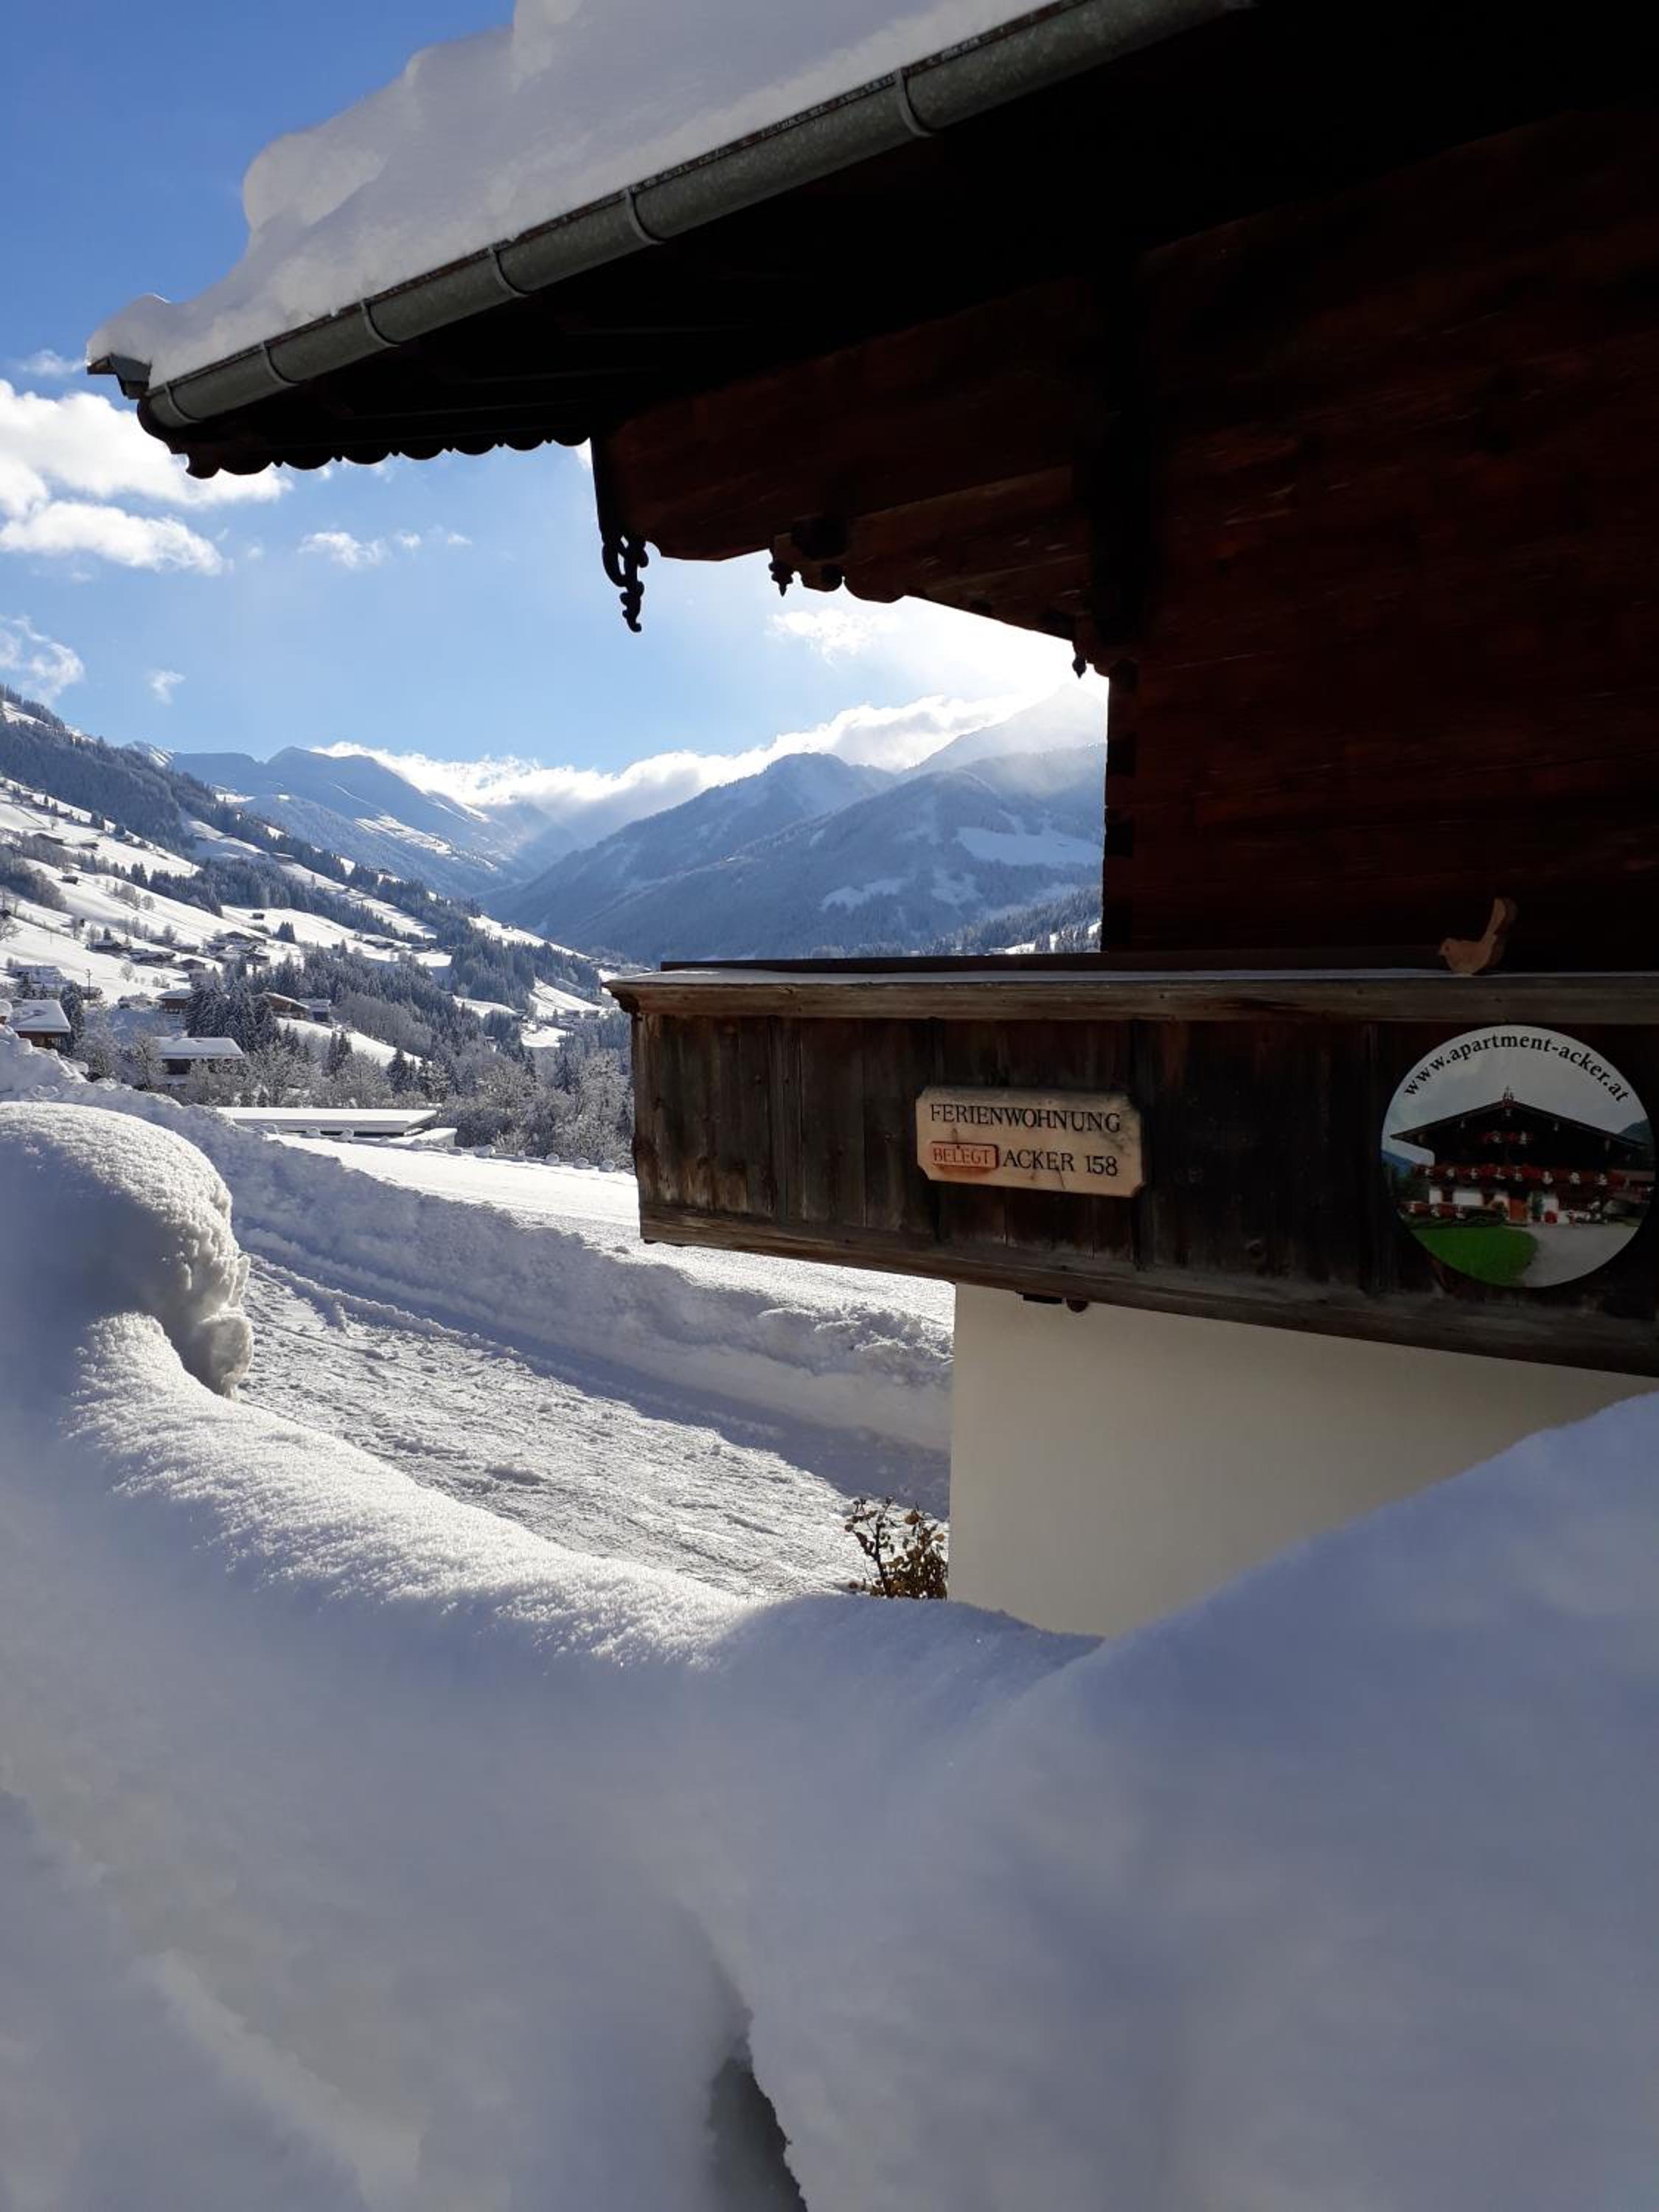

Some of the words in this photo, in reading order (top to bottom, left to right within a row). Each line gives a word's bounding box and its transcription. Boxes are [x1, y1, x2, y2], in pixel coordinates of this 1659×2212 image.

[1404, 1034, 1629, 1102] www.apartment-acker.at
[931, 1104, 1121, 1133] FERIENWOHNUNG
[933, 1148, 991, 1165] BELEGT
[1003, 1150, 1074, 1172] ACKER
[1085, 1155, 1118, 1176] 158
